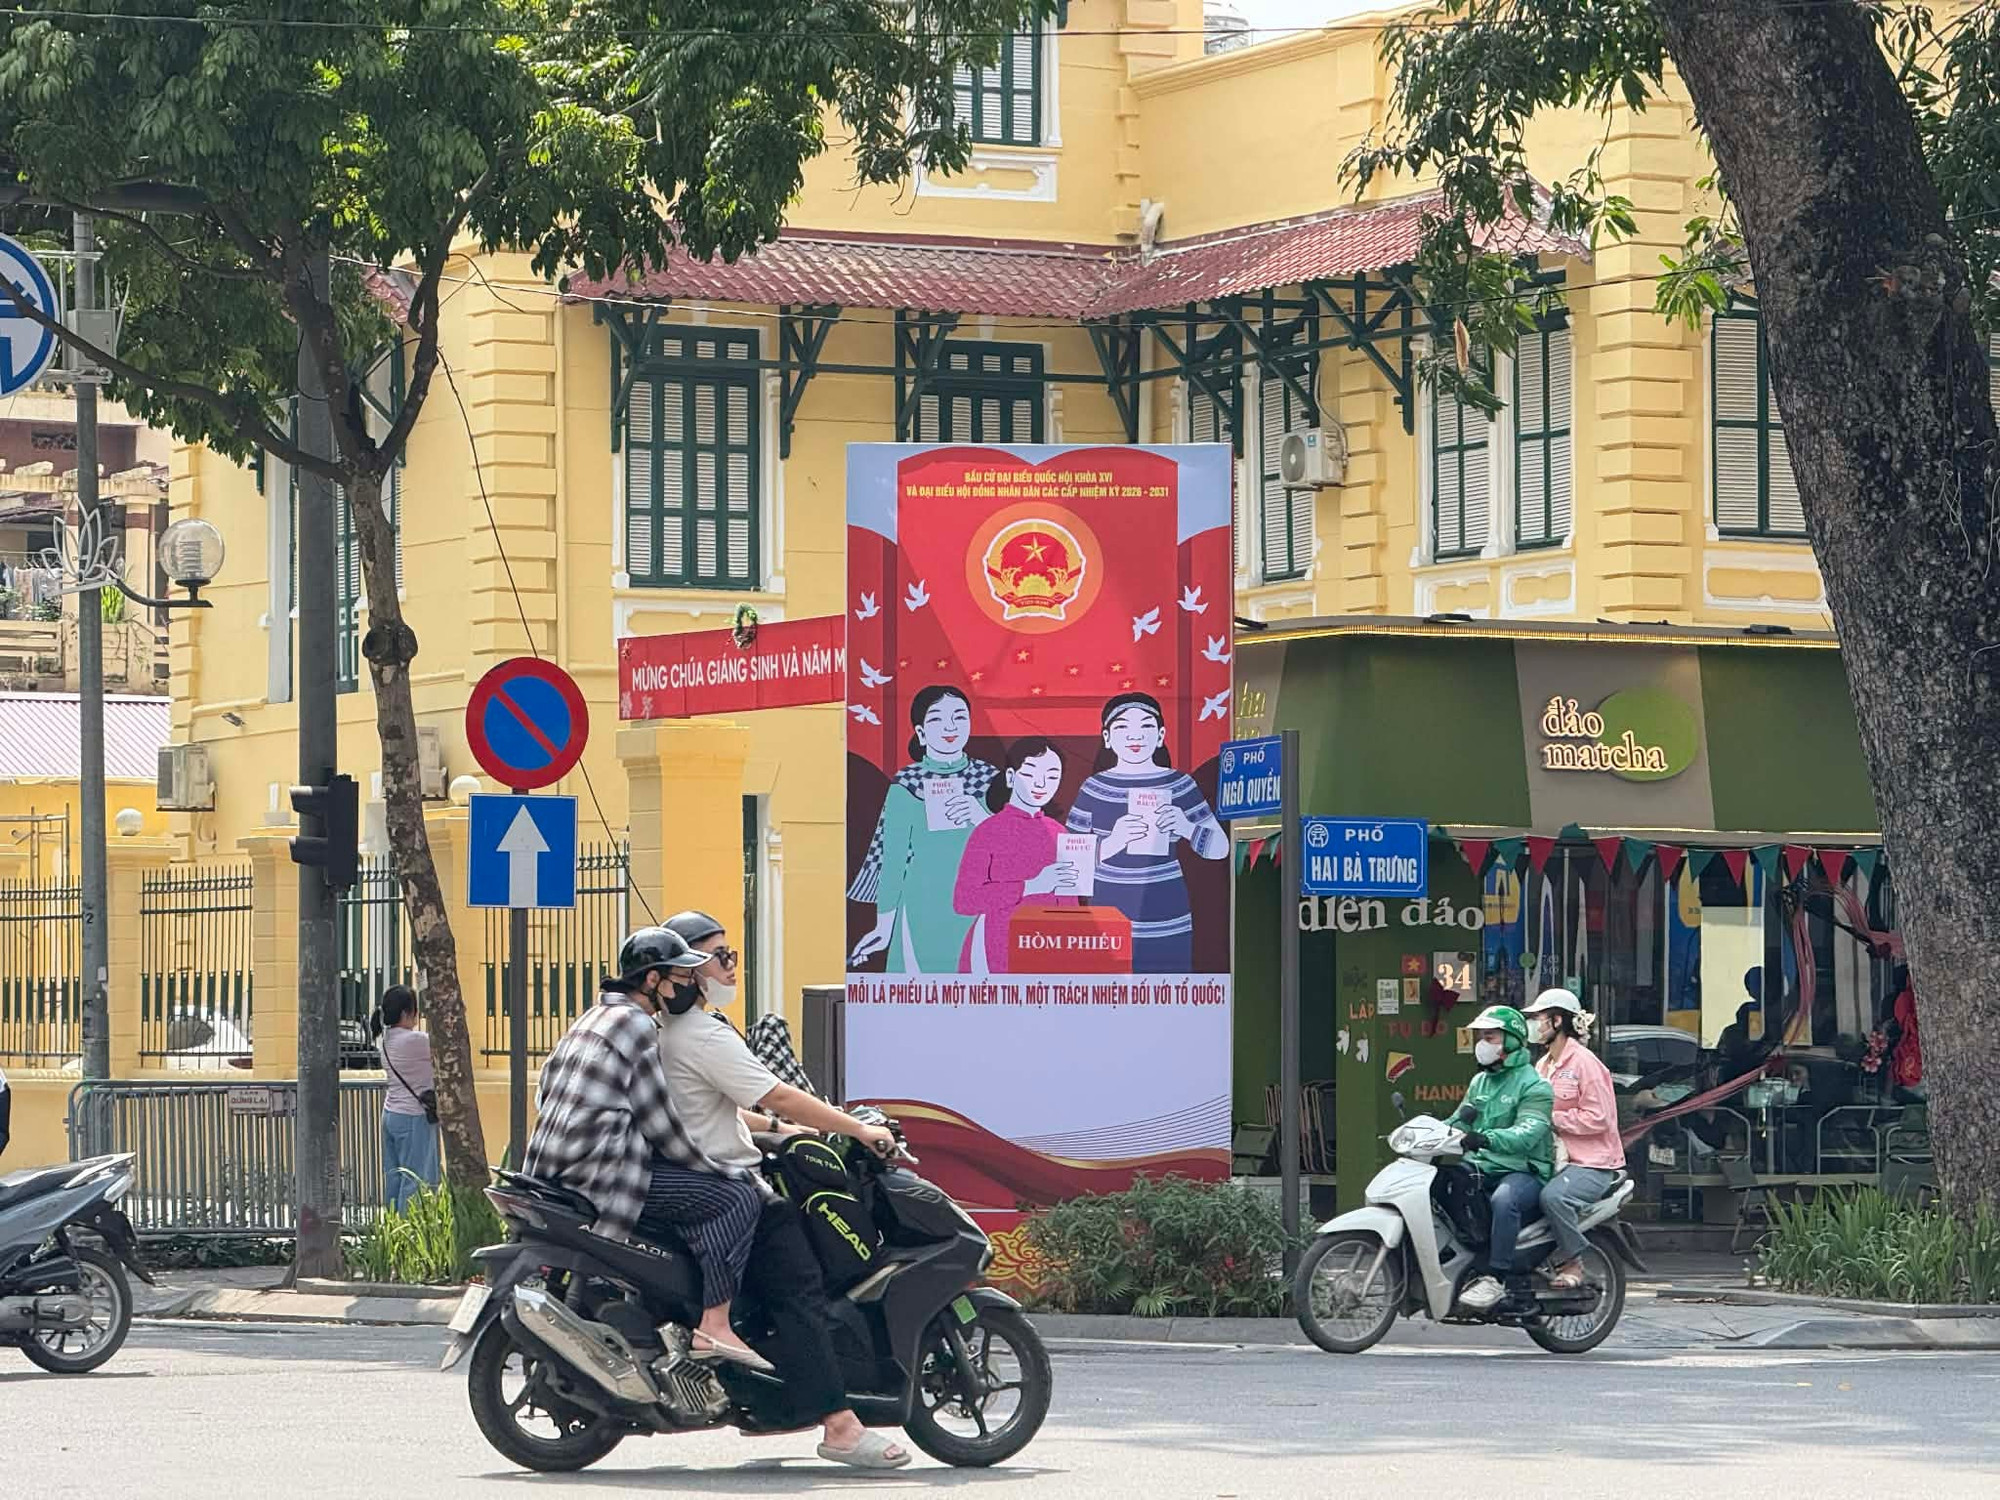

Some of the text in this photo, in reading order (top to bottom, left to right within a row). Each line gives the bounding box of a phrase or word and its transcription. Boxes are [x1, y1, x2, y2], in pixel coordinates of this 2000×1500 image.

[906, 484, 918, 497] VÀ
[919, 485, 934, 499] ĐẠI
[935, 482, 955, 497] BIỂU
[956, 484, 971, 499] HỘI
[997, 484, 1022, 497] NHÂN
[1022, 484, 1040, 497] DÂN
[1041, 484, 1060, 497] CÁC
[1061, 484, 1078, 497] CẤP
[1079, 485, 1107, 499] NHIỆM
[1121, 486, 1142, 497] 2026
[1149, 486, 1169, 497] 2031
[1034, 469, 1057, 484] QUỐC
[1058, 470, 1073, 485] HỘI
[1098, 471, 1113, 483] XVI
[632, 661, 668, 692] MỪNG
[670, 656, 705, 689] CHÚA
[707, 653, 748, 684] GIÁNG
[750, 656, 779, 682] SINH
[781, 645, 800, 679] VÀ
[802, 643, 832, 676] NĂM
[1543, 696, 1605, 738] đảo
[1243, 743, 1266, 765] PHỐ
[1544, 730, 1669, 772] matcha
[1222, 768, 1281, 807] NGÔ QUYỀN
[1345, 823, 1384, 842] PHỐ
[1311, 851, 1418, 883] HAI BÀ TRƯNG
[85, 912, 94, 924] 2
[1401, 897, 1485, 931] đảo
[1018, 931, 1122, 950] HÒM PHIẾU
[1438, 962, 1472, 990] 34
[848, 976, 1225, 1009] MỖI LÁ PHIẾU LÀ MỘT NIỀM TIN, MỘT TRÁCH NHIỆM ĐỐI VỚI TỔ QUỐC!
[817, 1201, 872, 1262] HEAD
